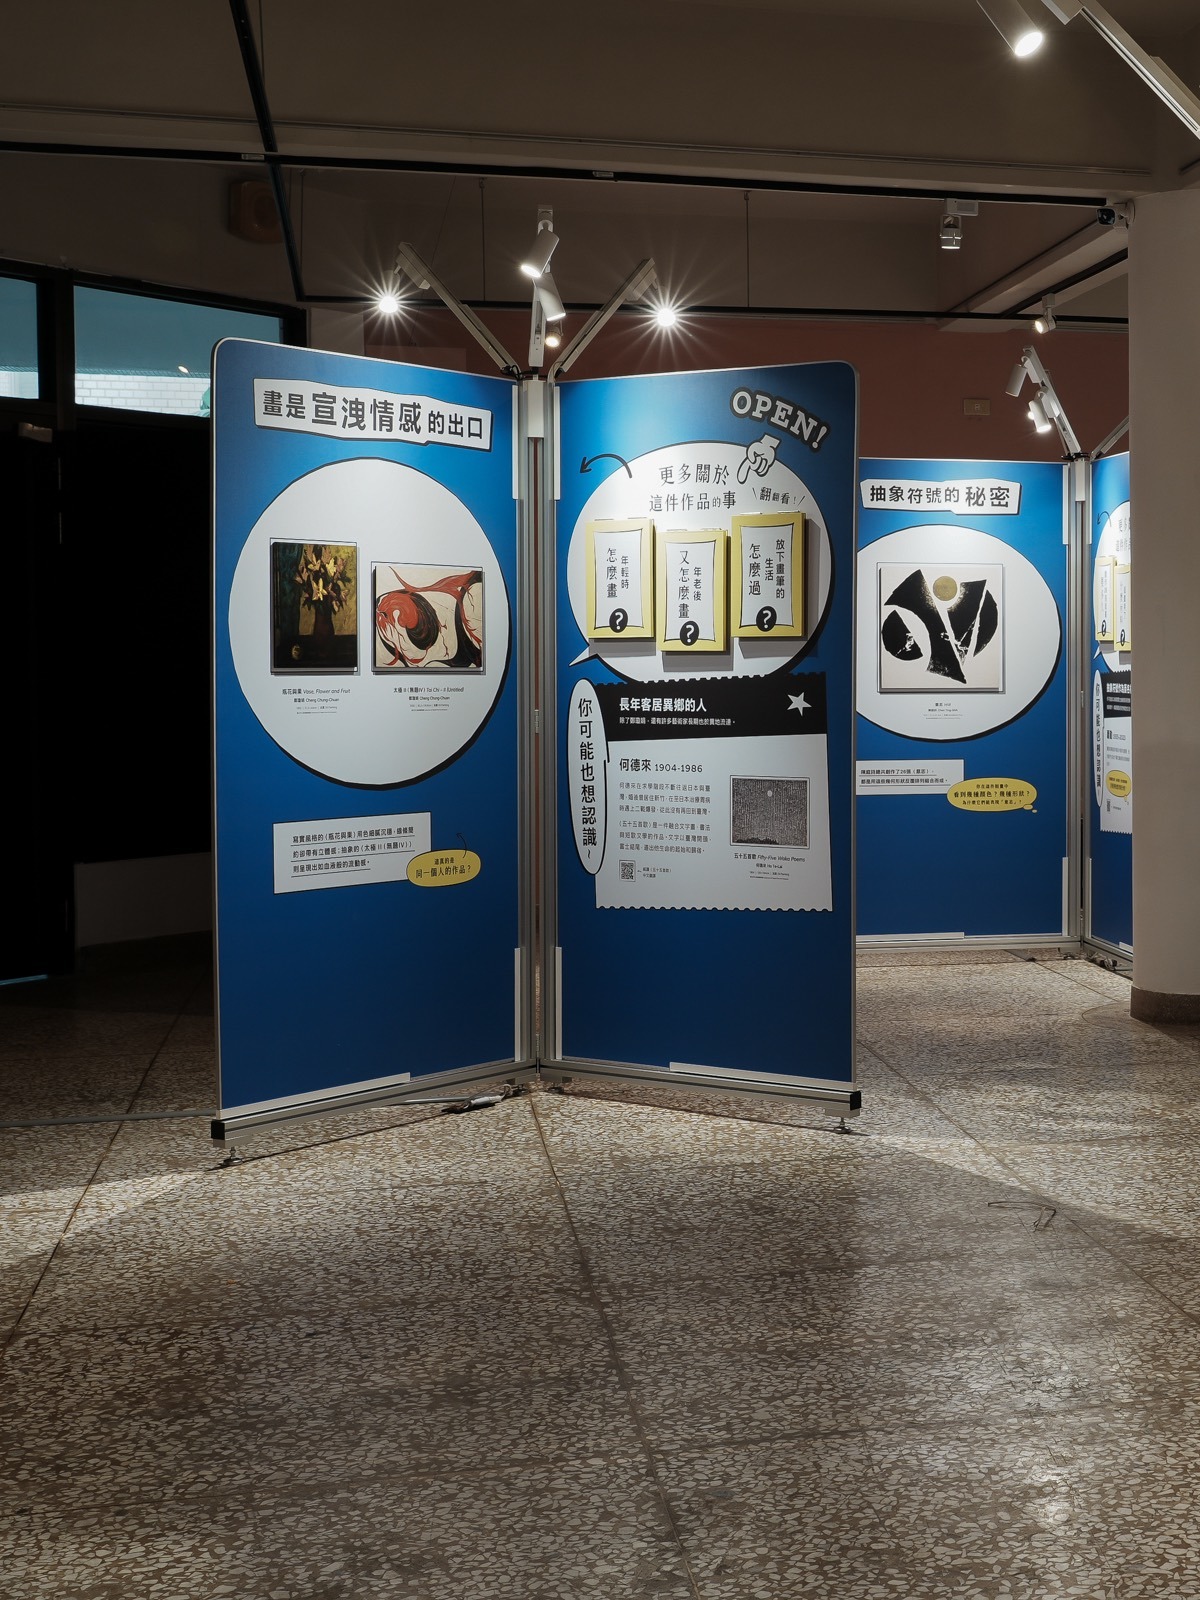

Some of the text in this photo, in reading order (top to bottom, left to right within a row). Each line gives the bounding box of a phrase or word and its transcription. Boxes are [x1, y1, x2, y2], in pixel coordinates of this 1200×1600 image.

[263, 390, 483, 439] 畫是宣洩情感的出口
[732, 390, 827, 449] OPEN!
[659, 463, 730, 486] 更多關於
[649, 490, 736, 512] 這件作品的事
[759, 487, 798, 505] 翻翻看!
[870, 485, 1010, 508] 抽象符號的秘密
[606, 548, 618, 598] 怎麼畫
[621, 556, 629, 590] 年輕時
[678, 551, 690, 619] 又怎麼畫
[693, 567, 702, 601] 年老後
[749, 544, 761, 596] 怎麼過
[765, 558, 774, 581] 生活
[776, 539, 785, 599] 放下畫筆的
[619, 698, 707, 712] 長年客居異鄉的人
[619, 758, 703, 773] 何德來 1904-1986
